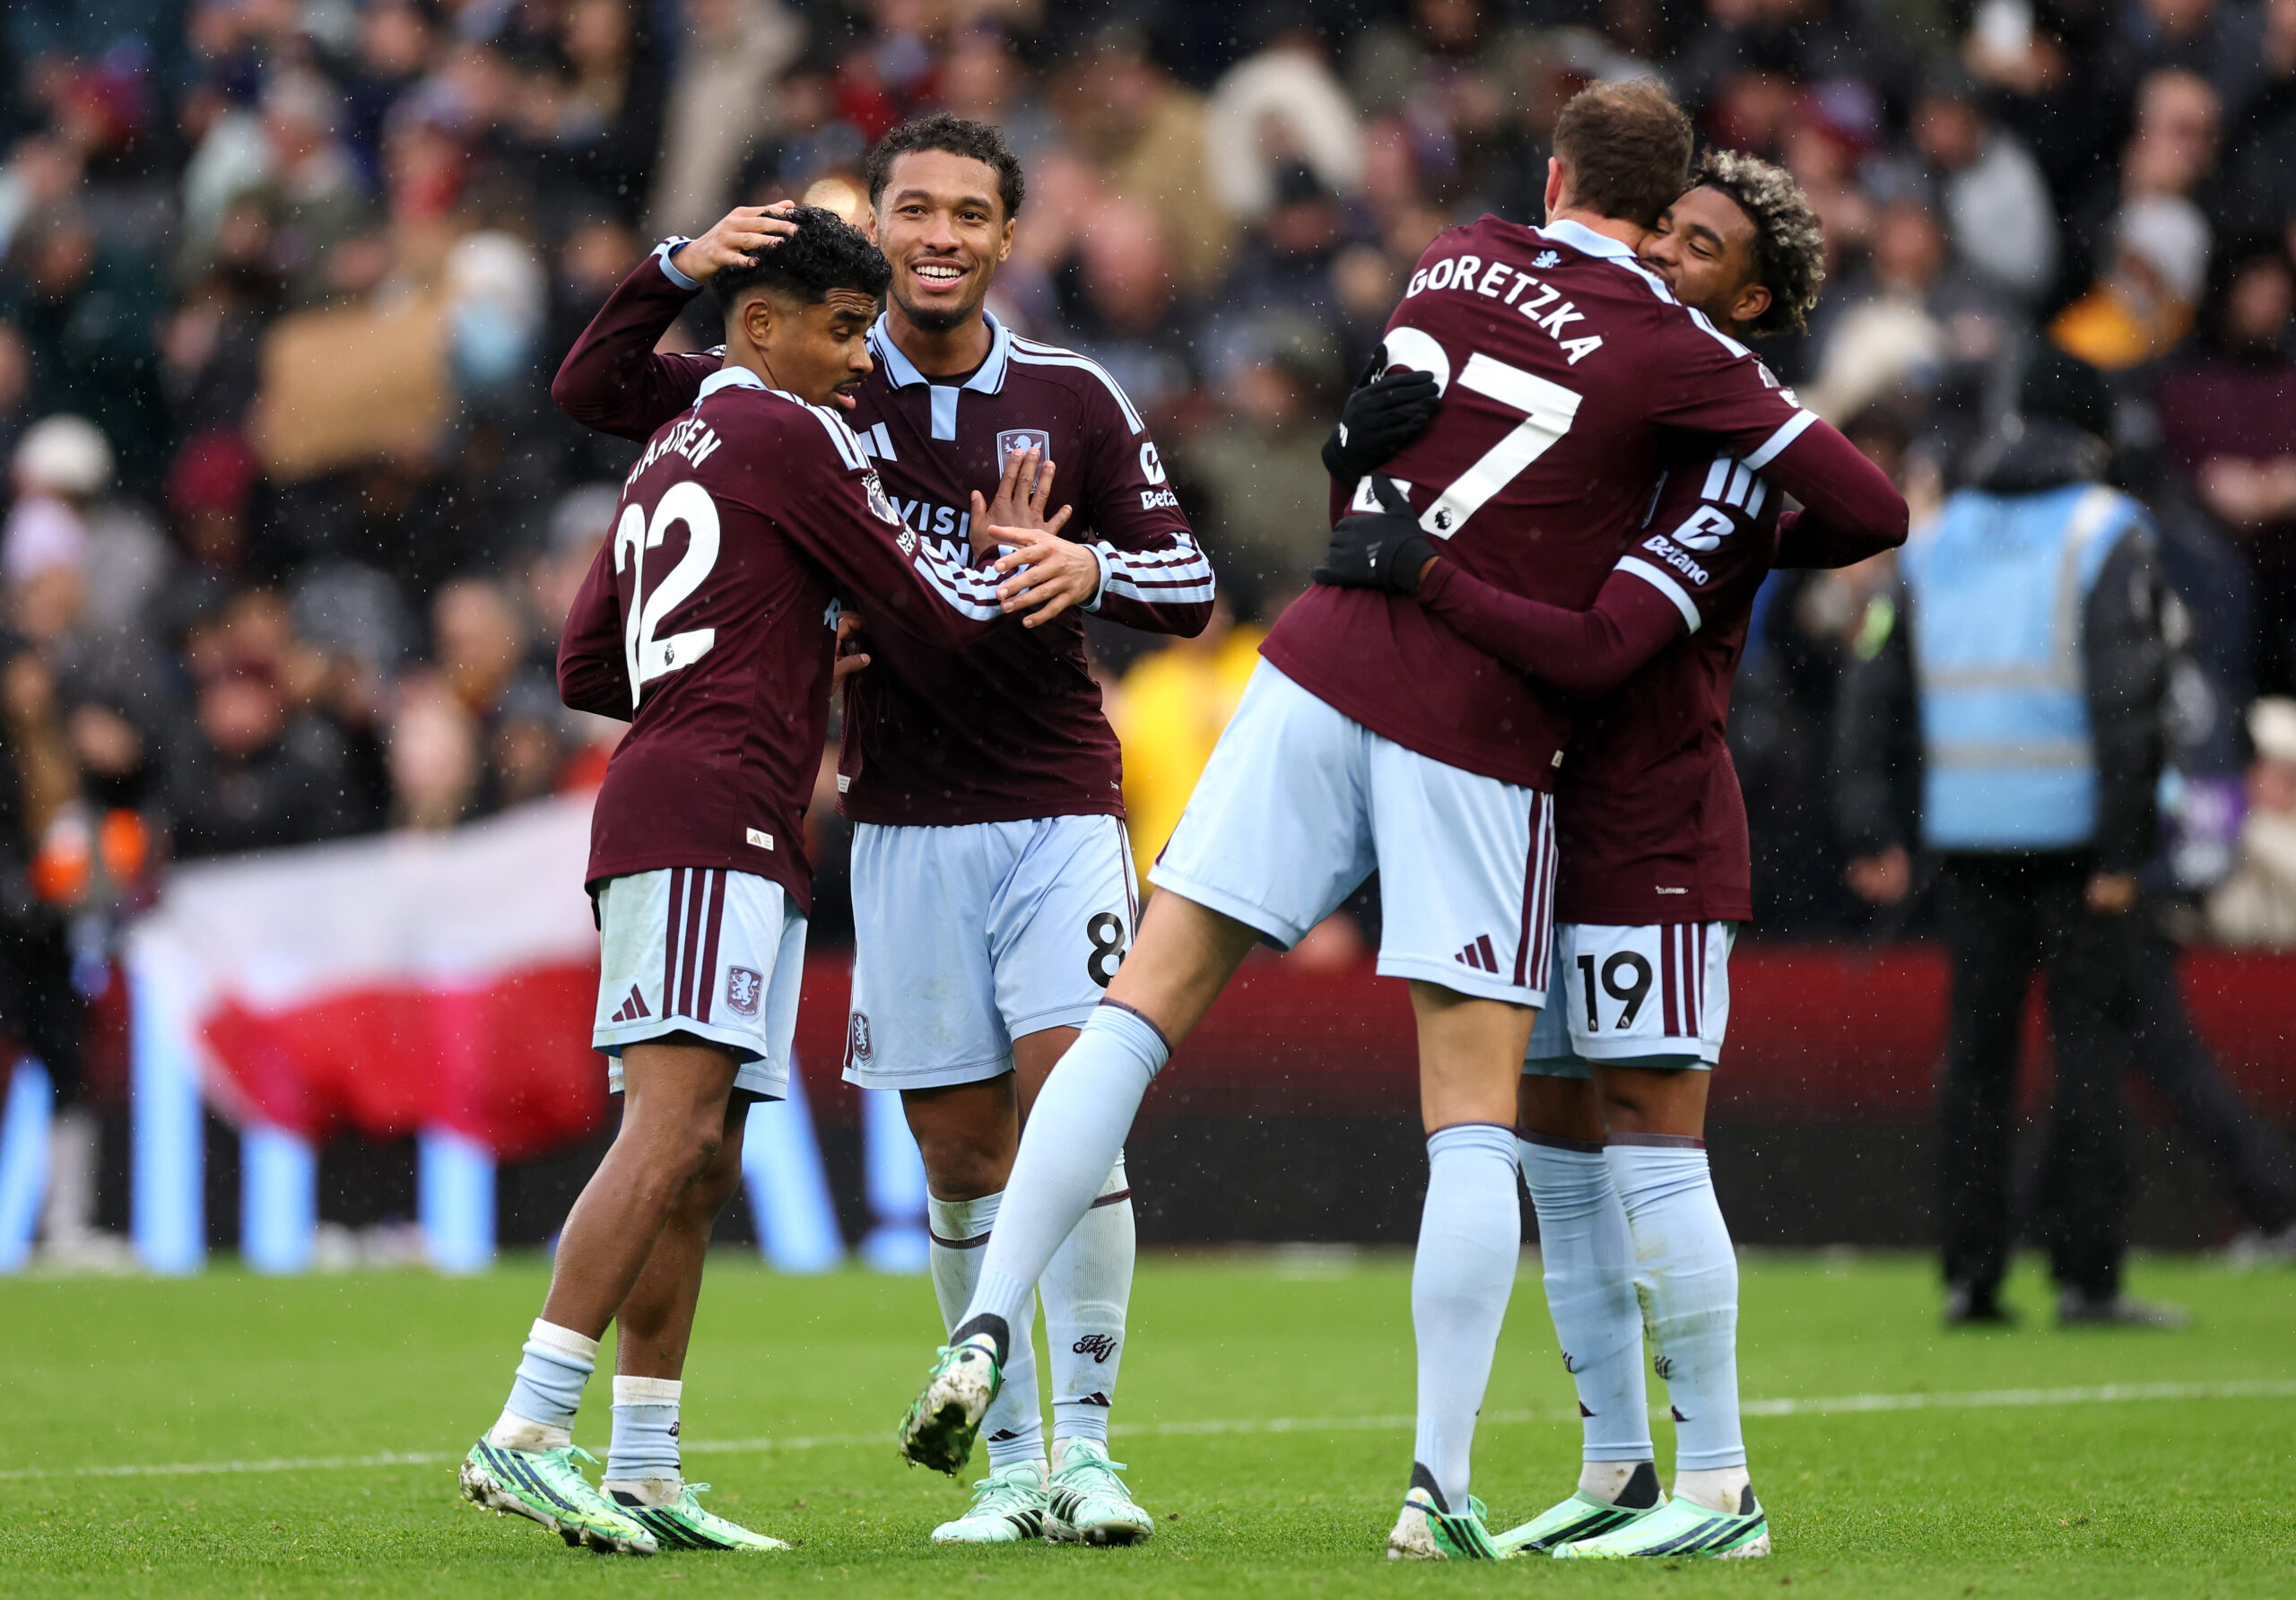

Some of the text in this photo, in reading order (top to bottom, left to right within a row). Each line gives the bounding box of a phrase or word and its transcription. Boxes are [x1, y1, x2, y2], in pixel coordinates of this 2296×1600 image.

[1406, 255, 1604, 366] GORETZKA
[890, 495, 970, 538] VISI
[1140, 489, 1179, 510] Beta
[613, 480, 721, 710] 22
[1641, 535, 1709, 586] Betano
[1086, 911, 1126, 989] 8
[1577, 950, 1653, 1032] 19
